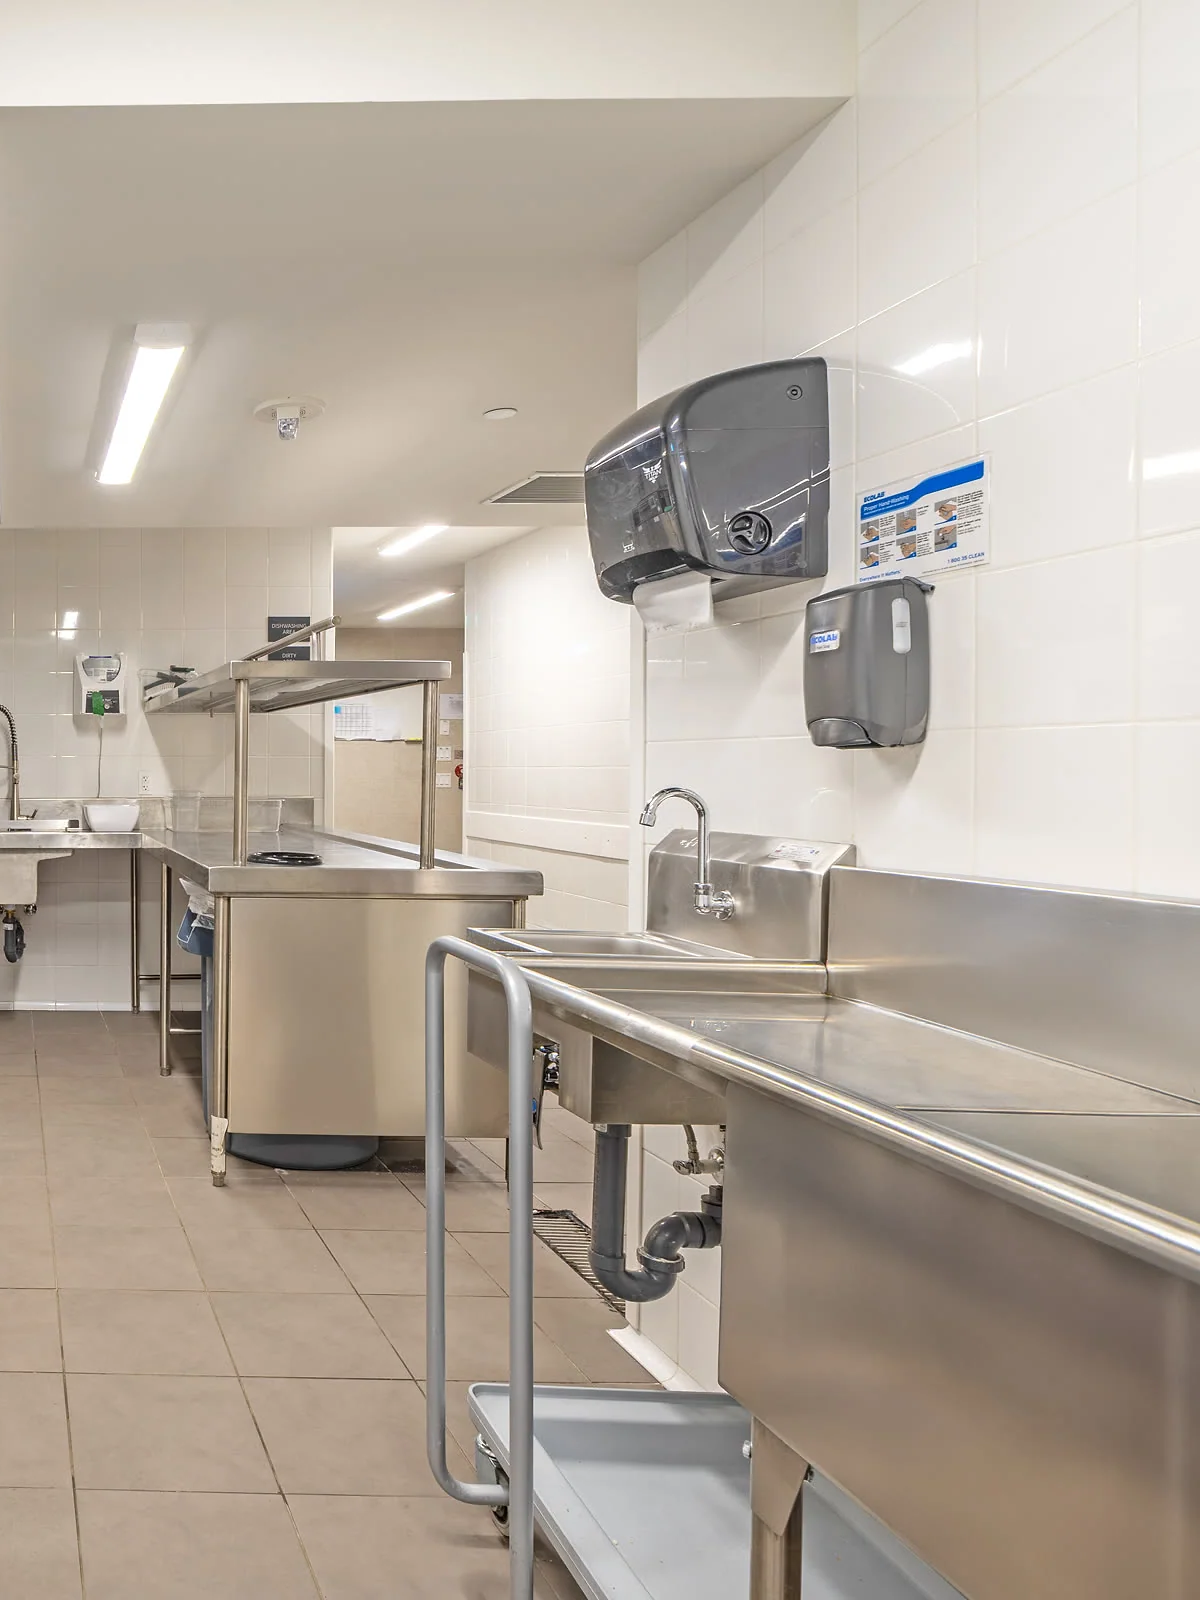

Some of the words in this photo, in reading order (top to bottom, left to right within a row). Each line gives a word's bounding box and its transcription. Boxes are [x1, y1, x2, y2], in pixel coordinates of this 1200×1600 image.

[644, 467, 662, 479] TITAN
[863, 491, 885, 503] ECOLAB
[863, 504, 878, 512] Proper
[968, 551, 985, 560] CLEAN
